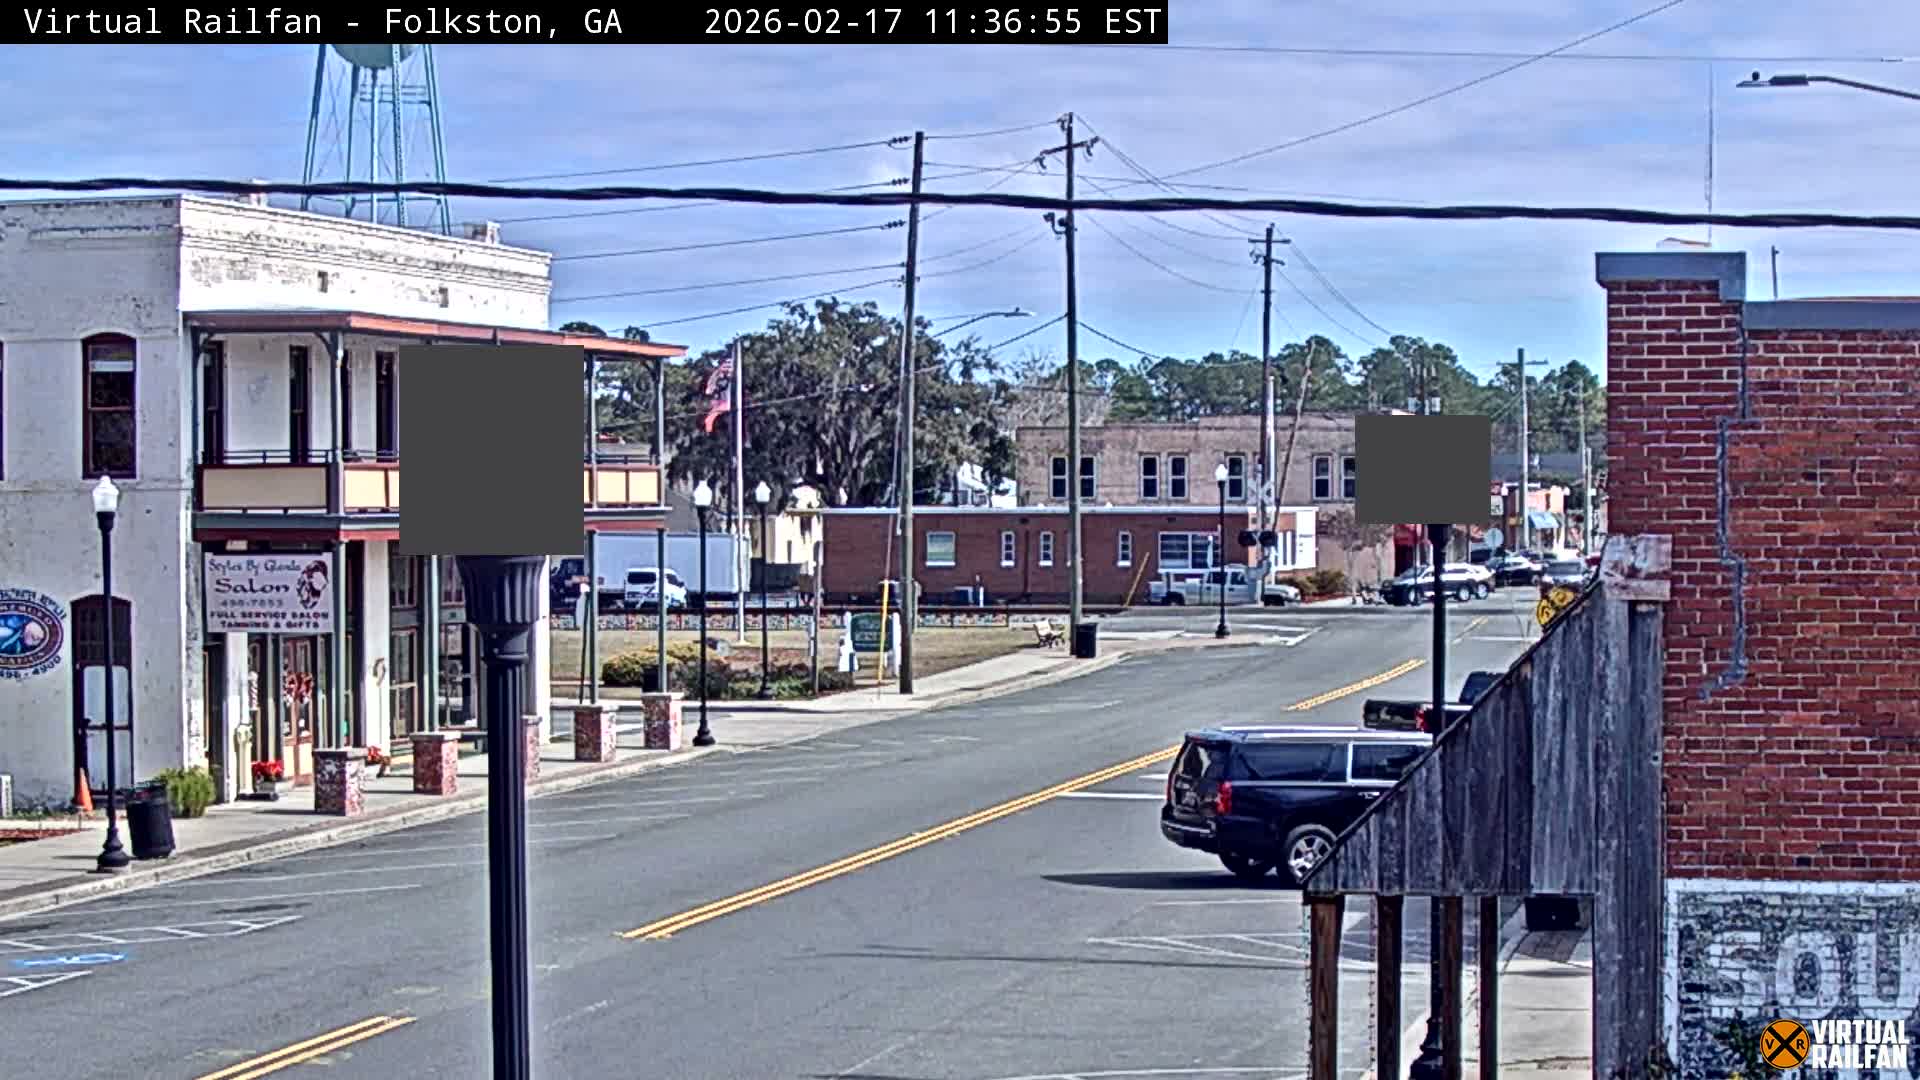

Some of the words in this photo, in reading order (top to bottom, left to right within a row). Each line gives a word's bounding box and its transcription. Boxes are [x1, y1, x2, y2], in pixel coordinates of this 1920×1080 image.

[246, 559, 259, 576] By
[214, 578, 290, 593] Salon
[210, 611, 236, 619] FULL
[240, 611, 287, 619] SERVICE
[291, 611, 329, 619] SALON
[220, 621, 270, 629] TANNING
[286, 621, 320, 629] GIFTS
